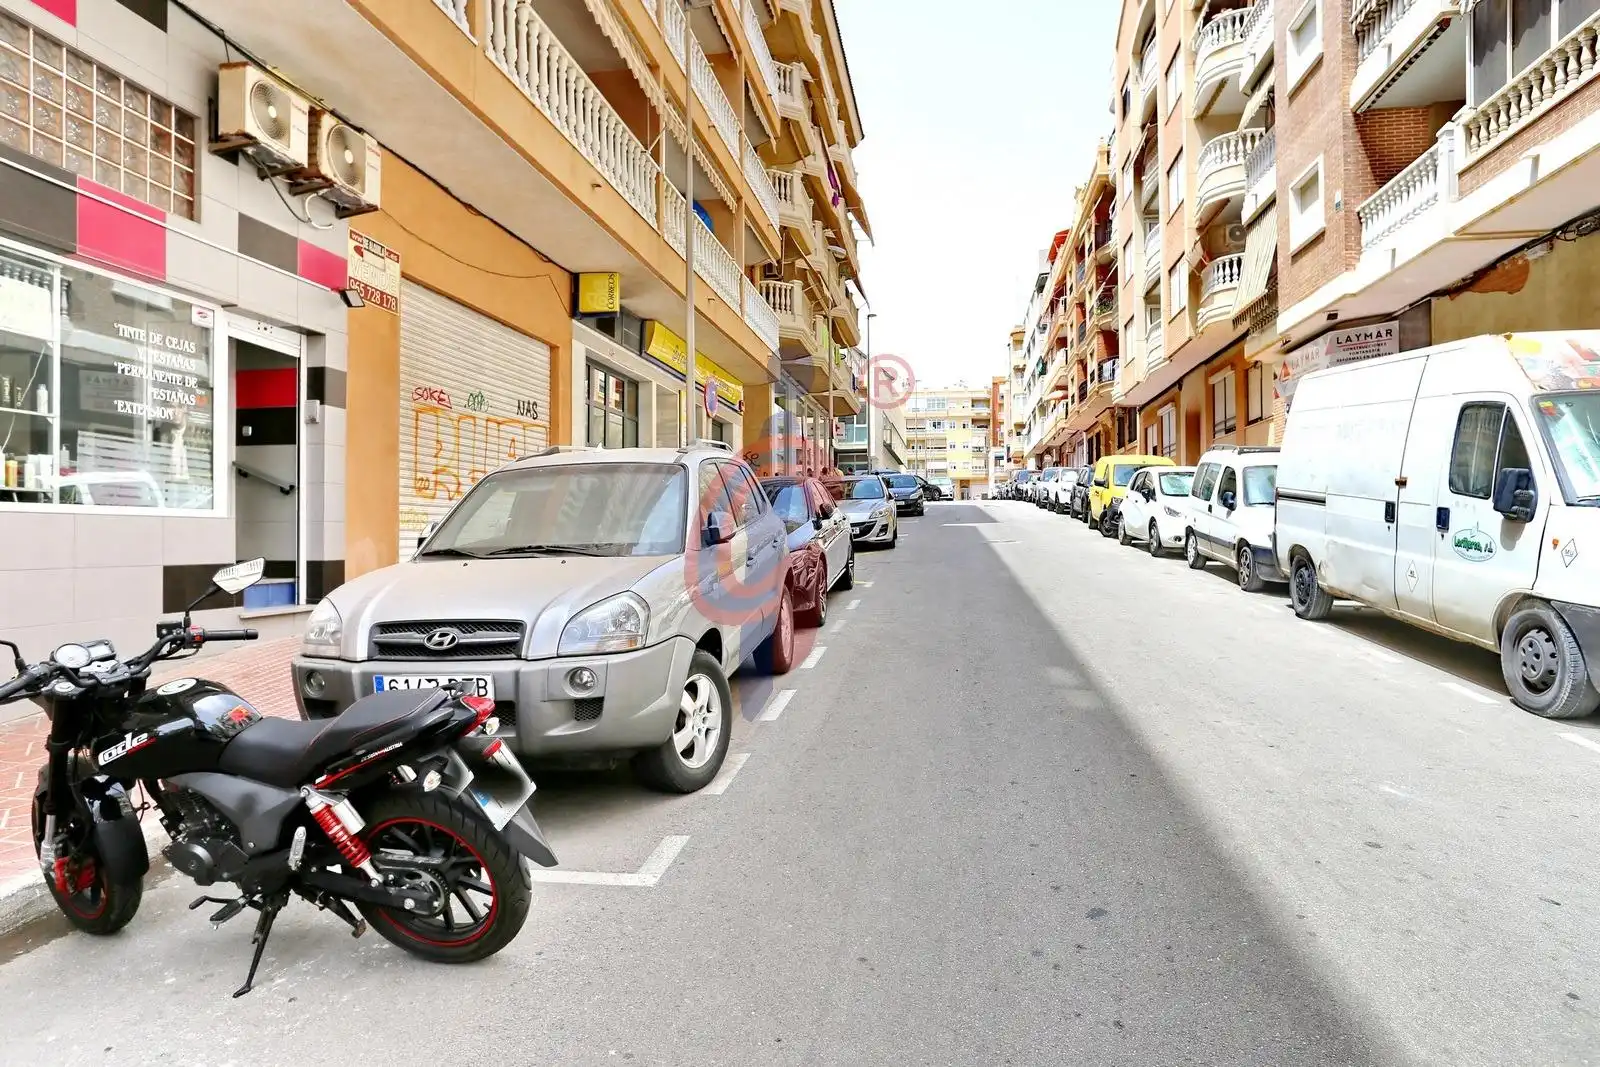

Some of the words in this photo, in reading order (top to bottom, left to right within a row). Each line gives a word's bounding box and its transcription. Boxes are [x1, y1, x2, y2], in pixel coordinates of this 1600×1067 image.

[366, 286, 381, 305] 728
[382, 294, 397, 311] 178
[607, 273, 616, 310] CORREOS
[149, 331, 163, 346] DE
[165, 335, 196, 354] CEJAS
[1336, 328, 1393, 345] LAYMAR
[150, 350, 196, 372] ESTAÑAS
[184, 375, 198, 389] DE
